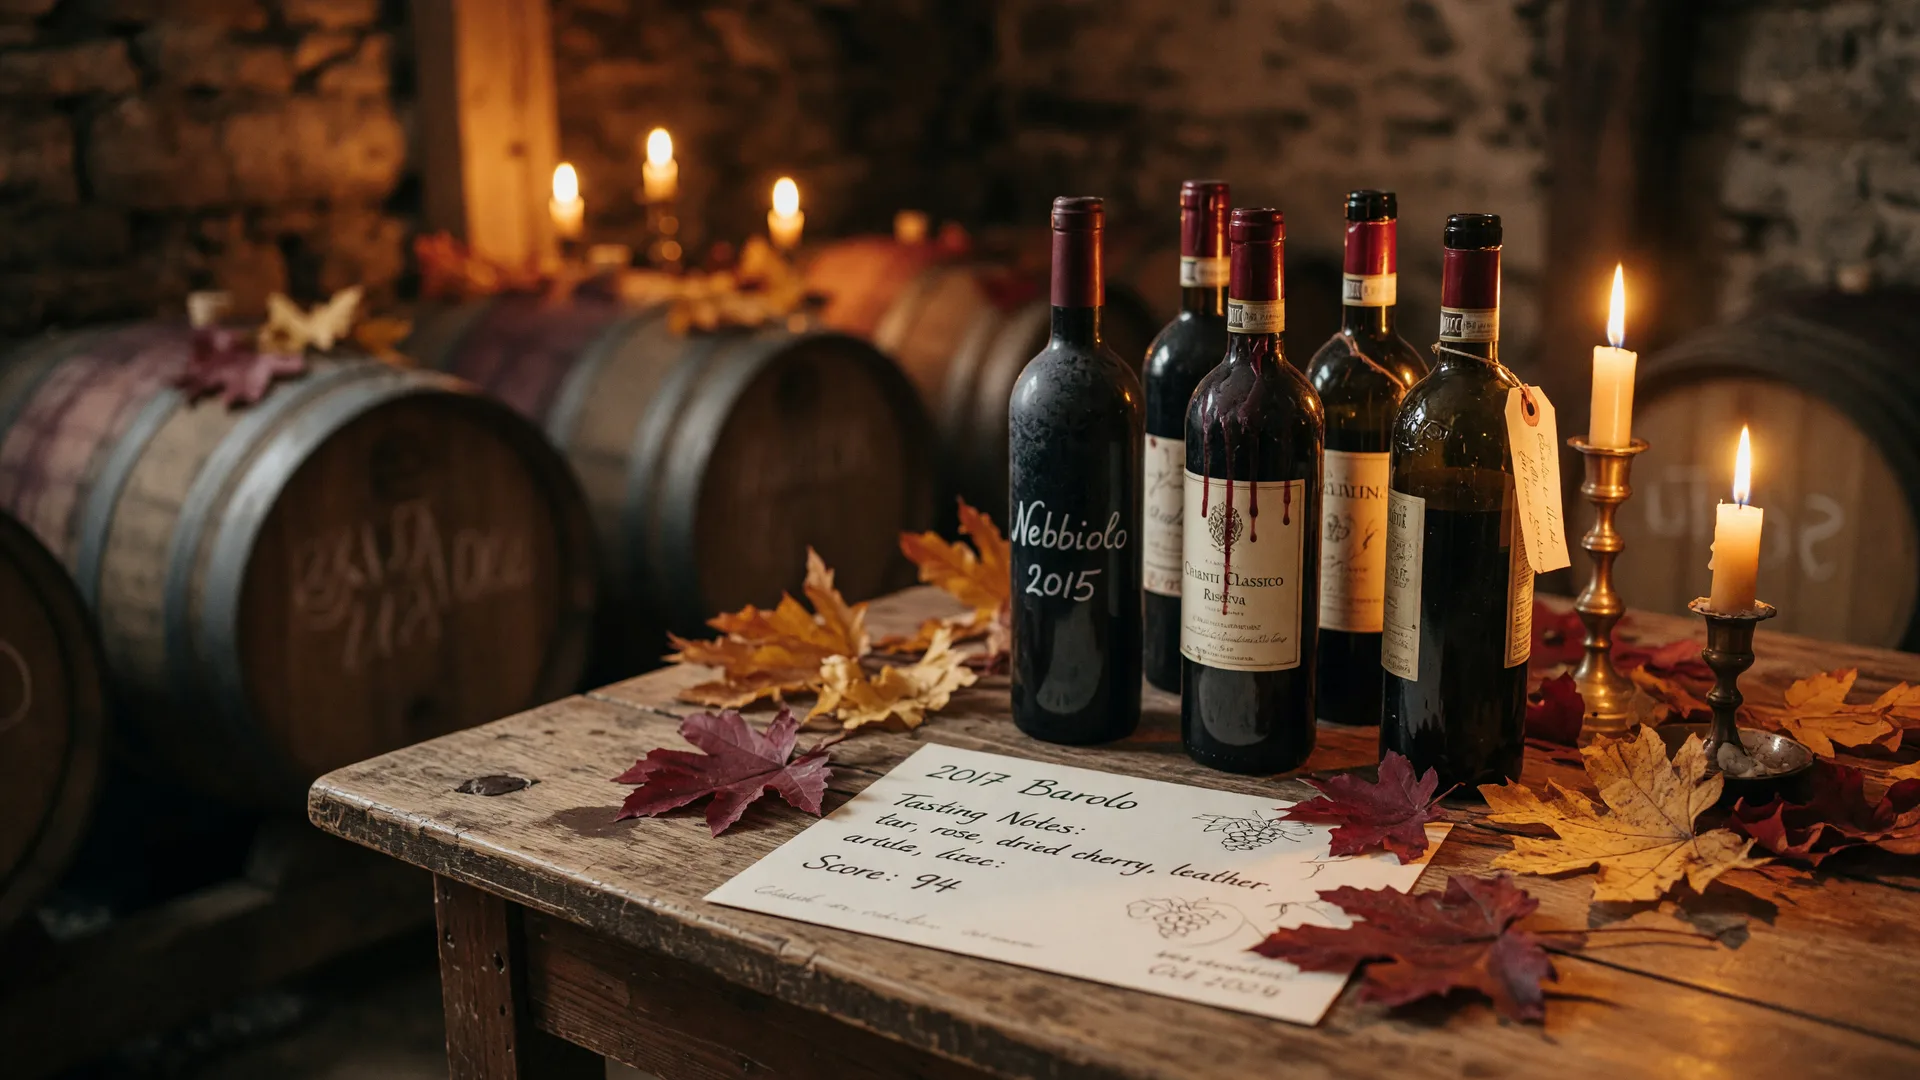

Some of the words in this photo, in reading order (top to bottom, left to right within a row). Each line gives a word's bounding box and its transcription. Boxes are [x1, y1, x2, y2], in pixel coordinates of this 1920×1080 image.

[1011, 500, 1127, 550] Nebbiolo
[1026, 564, 1102, 602] 2015
[926, 765, 1012, 787] 2017
[1017, 779, 1139, 810] Barolo
[892, 792, 989, 826] Tasting
[995, 810, 1086, 835] Notes:
[802, 854, 899, 882] Score:
[910, 873, 963, 894] 94
[875, 813, 918, 833] tar,
[929, 826, 984, 845] rose,
[995, 834, 1073, 856] dried
[1070, 848, 1155, 876] cherry,
[1169, 863, 1272, 892] leather.
